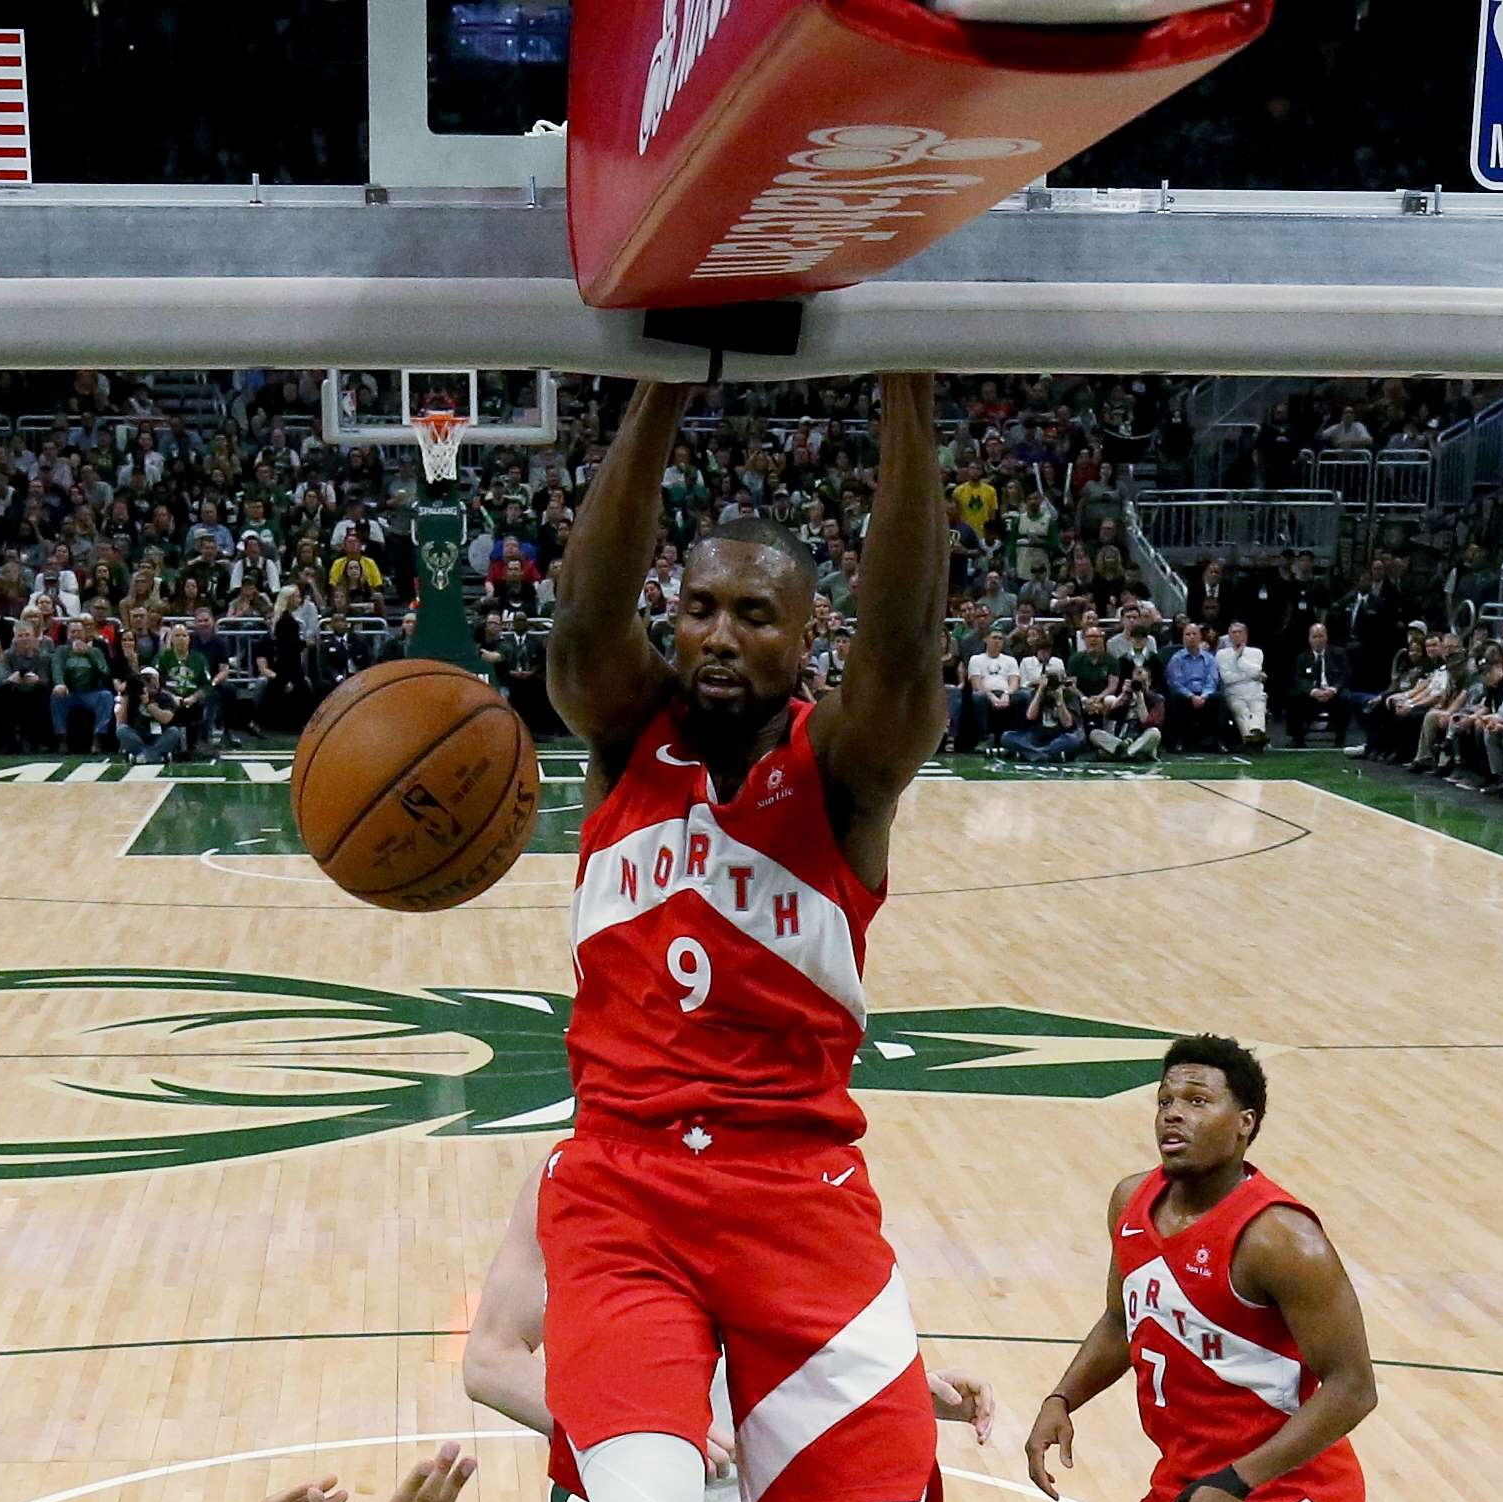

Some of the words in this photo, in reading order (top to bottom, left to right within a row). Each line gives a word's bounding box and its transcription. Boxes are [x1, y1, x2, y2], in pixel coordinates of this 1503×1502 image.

[619, 832, 800, 938] NORTH
[666, 936, 712, 1013] 9
[1128, 1277, 1224, 1362] ORTH
[1140, 1347, 1168, 1408] 7
